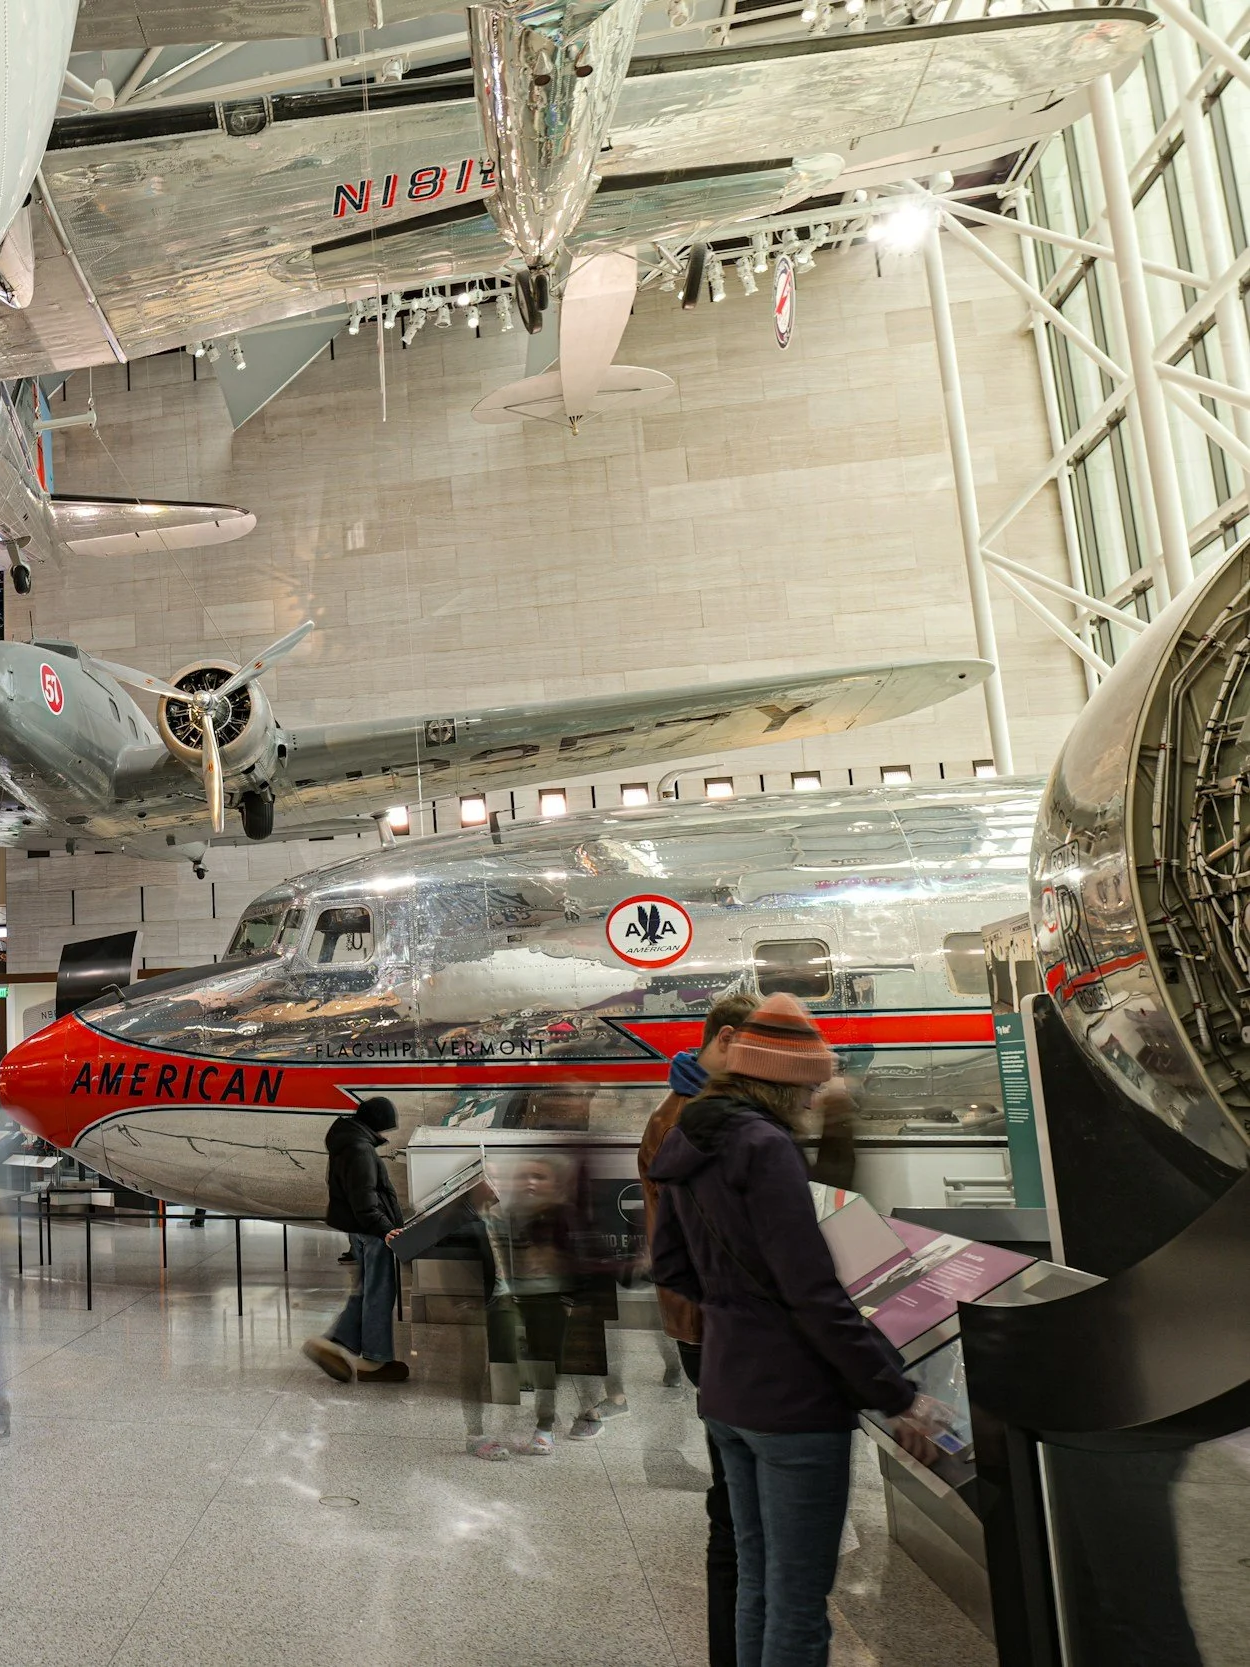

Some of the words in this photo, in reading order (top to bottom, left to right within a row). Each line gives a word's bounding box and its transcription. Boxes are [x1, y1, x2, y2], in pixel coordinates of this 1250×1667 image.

[1052, 845, 1077, 871] ROLLS
[625, 944, 681, 954] AMERICAN
[315, 1042, 412, 1058] FLAGSHIP
[434, 1038, 546, 1056] VERMONT
[69, 1061, 285, 1103] AMERICAN
